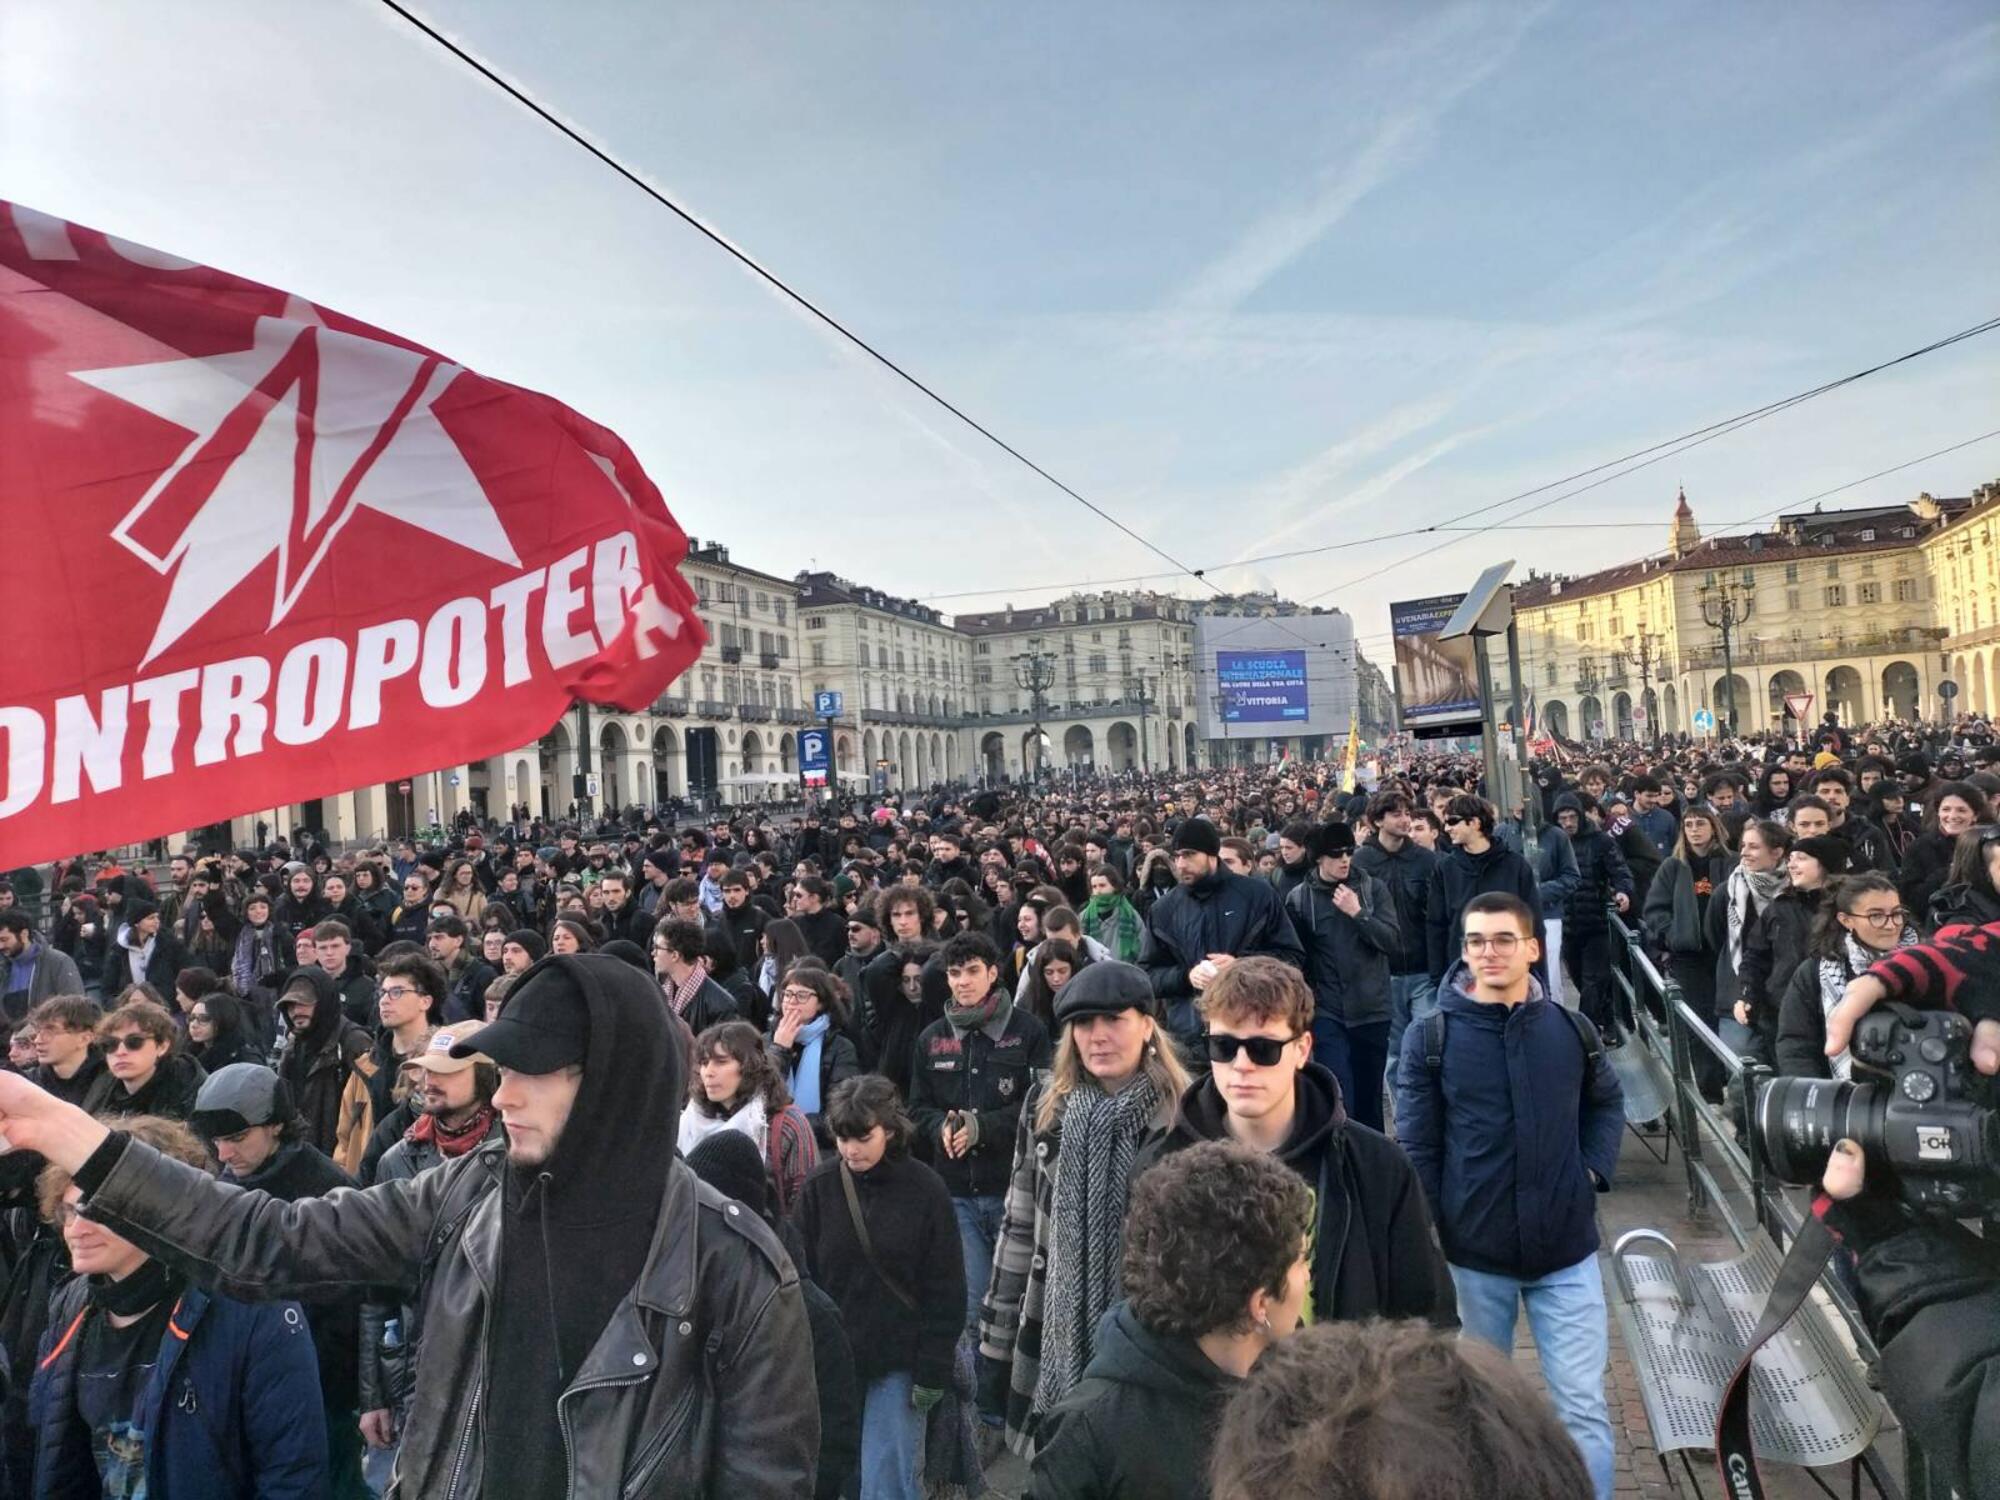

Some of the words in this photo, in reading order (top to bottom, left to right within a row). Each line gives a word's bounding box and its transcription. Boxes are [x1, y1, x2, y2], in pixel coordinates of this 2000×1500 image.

[1247, 660, 1287, 670] SCUOLA
[819, 697, 831, 711] P
[1247, 697, 1288, 705] VITTORIA
[805, 739, 822, 761] P
